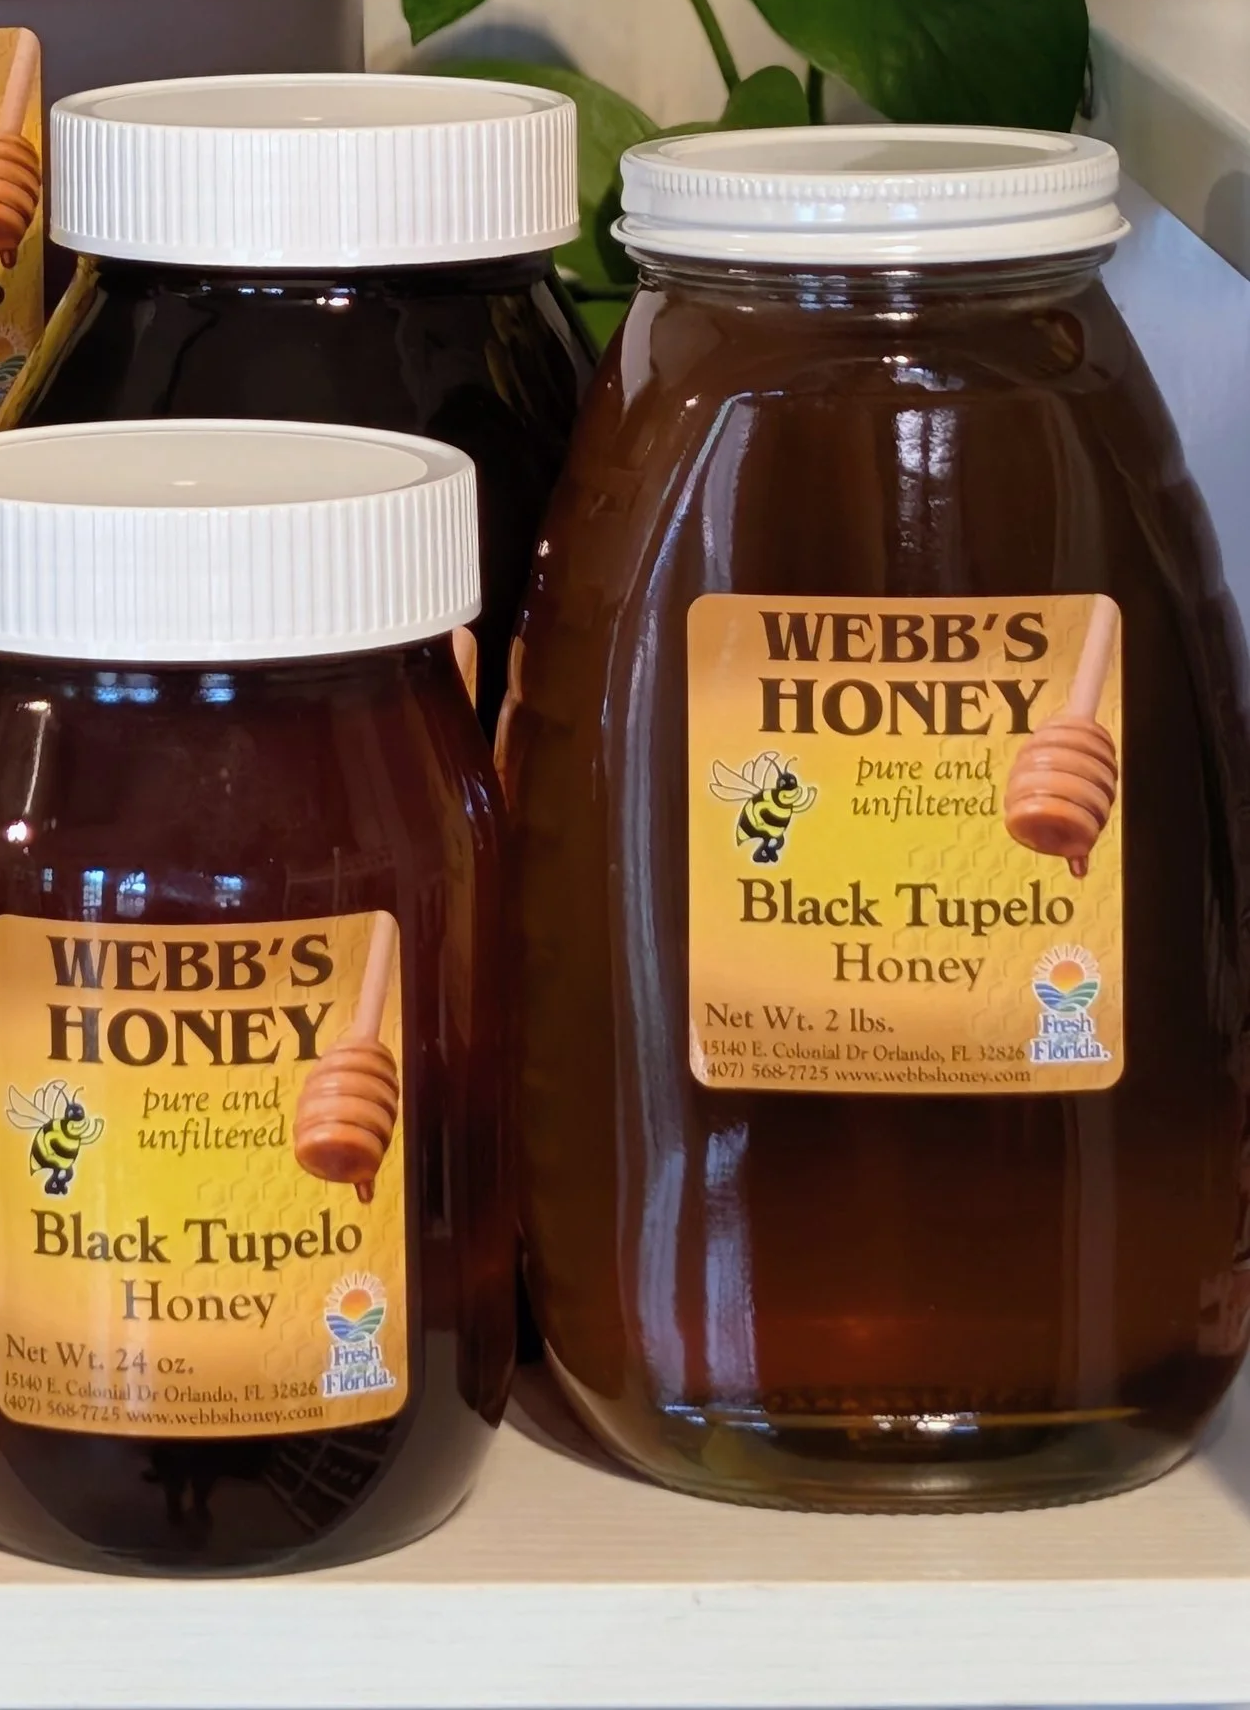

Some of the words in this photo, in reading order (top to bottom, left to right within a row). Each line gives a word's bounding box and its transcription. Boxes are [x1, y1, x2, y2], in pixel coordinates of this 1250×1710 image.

[759, 610, 1049, 663] WEBB'S
[758, 677, 1049, 735] HONEY
[855, 756, 921, 786] pure
[934, 748, 992, 781] and
[851, 784, 997, 822] unfiltered
[736, 877, 881, 927] Black
[894, 879, 1074, 936] Tupelo
[46, 933, 333, 992] WEBB'S
[831, 942, 984, 990] Honey
[46, 1001, 333, 1067] HONEY
[705, 1003, 754, 1029] Net
[763, 1006, 813, 1031] Wt.
[825, 1009, 840, 1031] 2
[850, 1009, 894, 1034] lbs.
[1042, 1013, 1092, 1034] Fresh
[703, 1040, 746, 1056] 15140
[752, 1042, 767, 1057] E.
[773, 1042, 840, 1060] Colonial
[846, 1045, 868, 1061] Dr
[873, 1045, 945, 1062] Orlando,
[951, 1045, 971, 1061] FL
[979, 1045, 1025, 1061] 32826
[751, 1063, 829, 1081] 568-7725
[835, 1066, 1031, 1084] www.webbshoney.com
[143, 1087, 210, 1118] pure
[222, 1077, 281, 1111] and
[137, 1114, 287, 1156] unfiltered
[30, 1208, 170, 1264] Black
[184, 1209, 362, 1272] Tupelo
[119, 1278, 277, 1327] Honey
[6, 1333, 47, 1364] Net
[56, 1342, 104, 1370] Wt.
[116, 1348, 147, 1374] 24
[157, 1357, 194, 1374] oz.
[334, 1340, 380, 1366] Fresh
[5, 1370, 42, 1391] 15140
[66, 1380, 131, 1400] Colonial
[138, 1385, 157, 1402] Dr
[164, 1386, 238, 1403] Orlando,
[245, 1386, 264, 1401] FL
[273, 1381, 318, 1400] 32826
[4, 1393, 41, 1414] (407)
[47, 1400, 121, 1421] 568-7725
[127, 1406, 324, 1425] www.webbshoney.com
